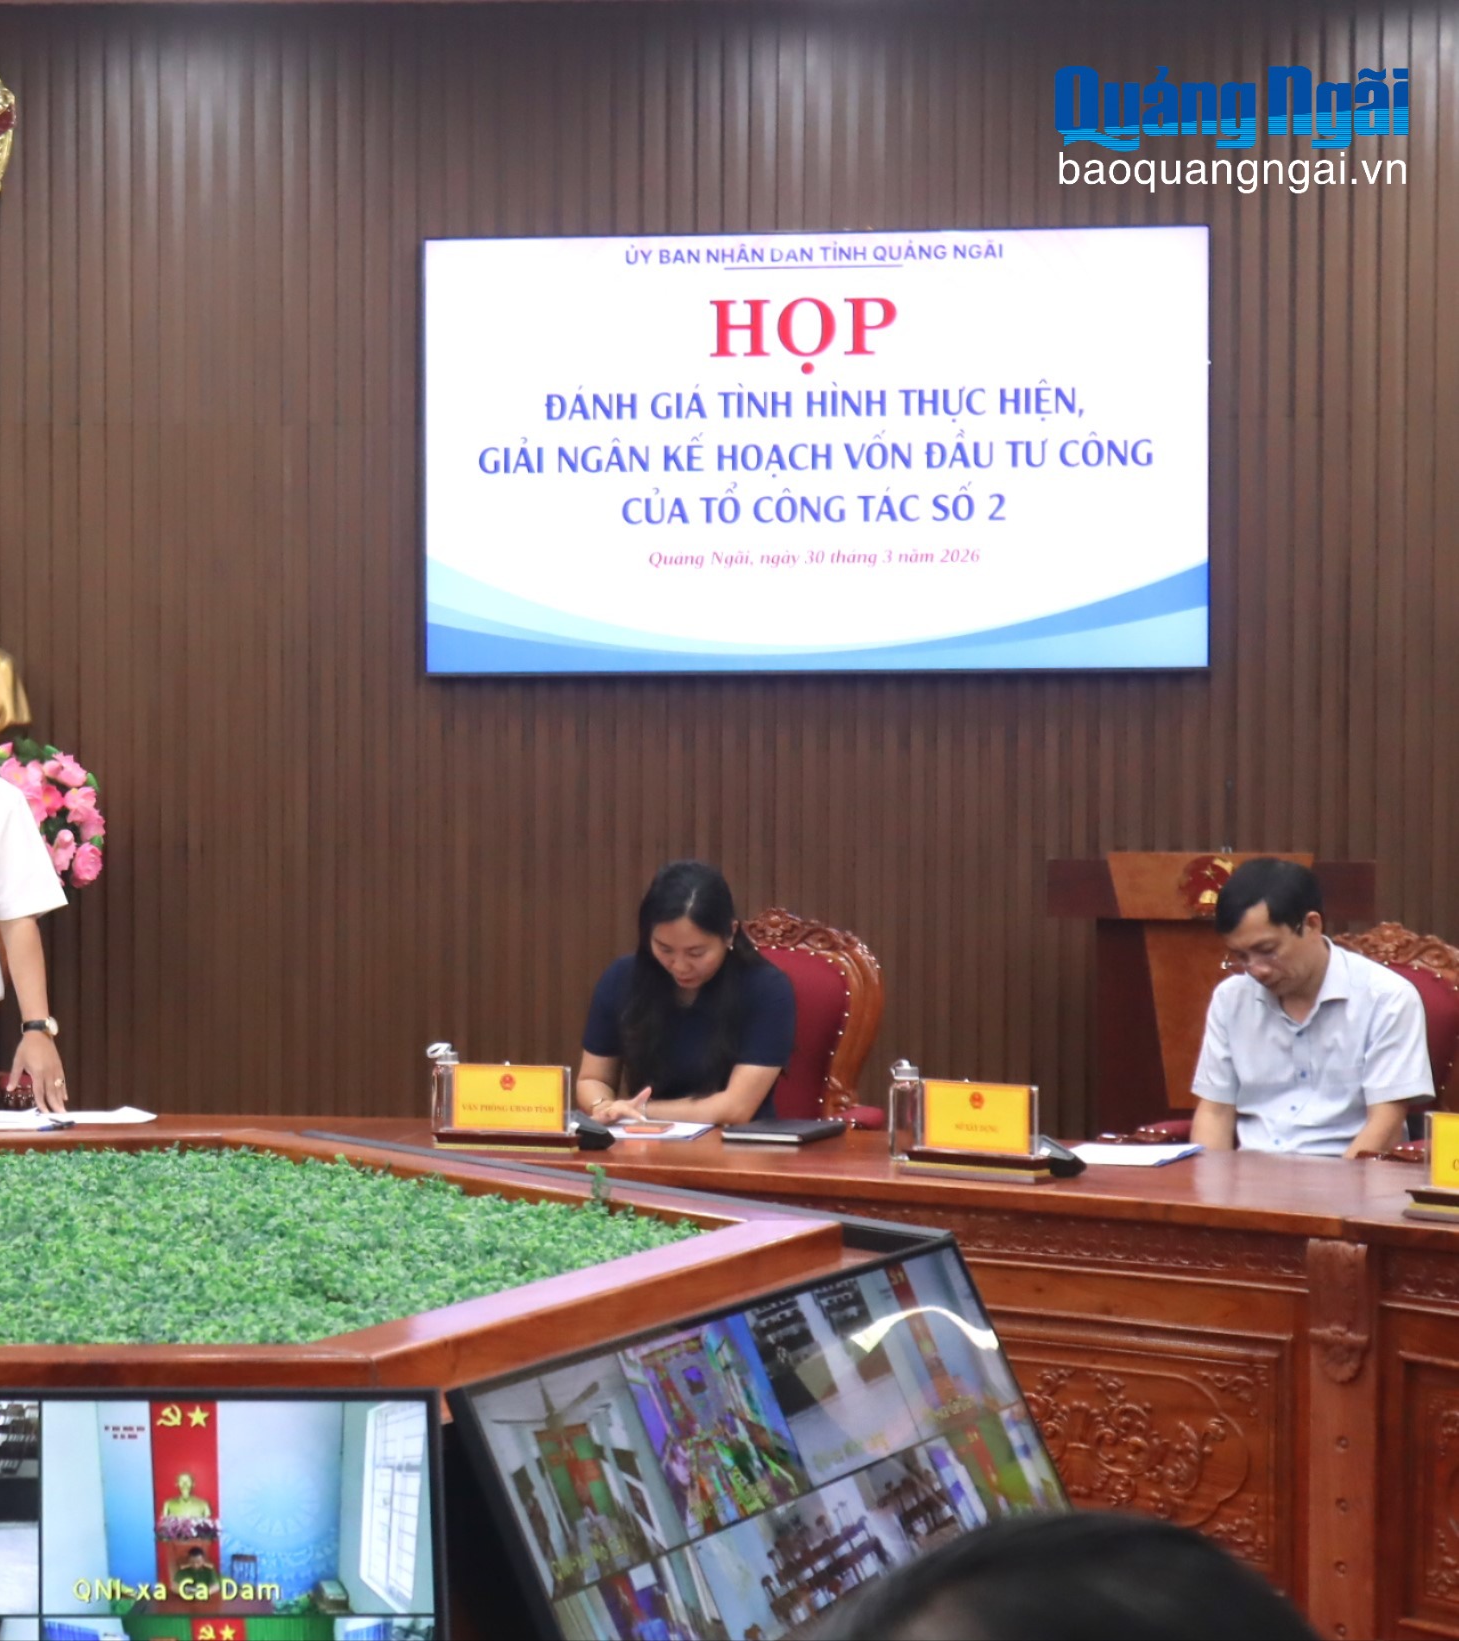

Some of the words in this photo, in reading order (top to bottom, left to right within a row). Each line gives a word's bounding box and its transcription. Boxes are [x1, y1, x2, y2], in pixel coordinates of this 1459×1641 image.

[625, 243, 652, 265] ỦY
[658, 248, 701, 265] BAN
[706, 243, 765, 264] NHÂN
[820, 240, 867, 262] TỈNH
[872, 239, 948, 262] QUẢNG
[953, 239, 1004, 260] NGÃI
[709, 297, 898, 375] HỌP
[544, 384, 638, 421] ĐÁNH
[650, 383, 708, 420] GIÁ
[717, 382, 793, 419] TÌNH
[806, 381, 887, 418] HÌNH
[898, 386, 987, 423] THỰC
[999, 378, 1085, 421] HIỆN,
[478, 436, 544, 475] GIẢI
[557, 437, 650, 474] NGÂN
[663, 432, 705, 473] KẾ
[716, 443, 833, 479] HOẠCH
[843, 429, 912, 470] VỐN
[925, 429, 994, 469] ĐẦU
[1005, 438, 1049, 468] TƯ
[1059, 430, 1154, 468] CÔNG
[621, 487, 690, 525] CỦA
[699, 481, 741, 525] TỔ
[753, 487, 846, 524] CÔNG
[857, 486, 920, 523] TÁC
[932, 481, 975, 522] SỐ
[988, 493, 1006, 521] 2
[759, 551, 800, 568] ngày
[804, 550, 825, 565] 30
[830, 548, 877, 568] tháng
[883, 549, 893, 564] 3
[898, 548, 935, 564] năm
[939, 548, 981, 563] 2026
[178, 1578, 209, 1601] Ca
[221, 1578, 280, 1601] Dam
